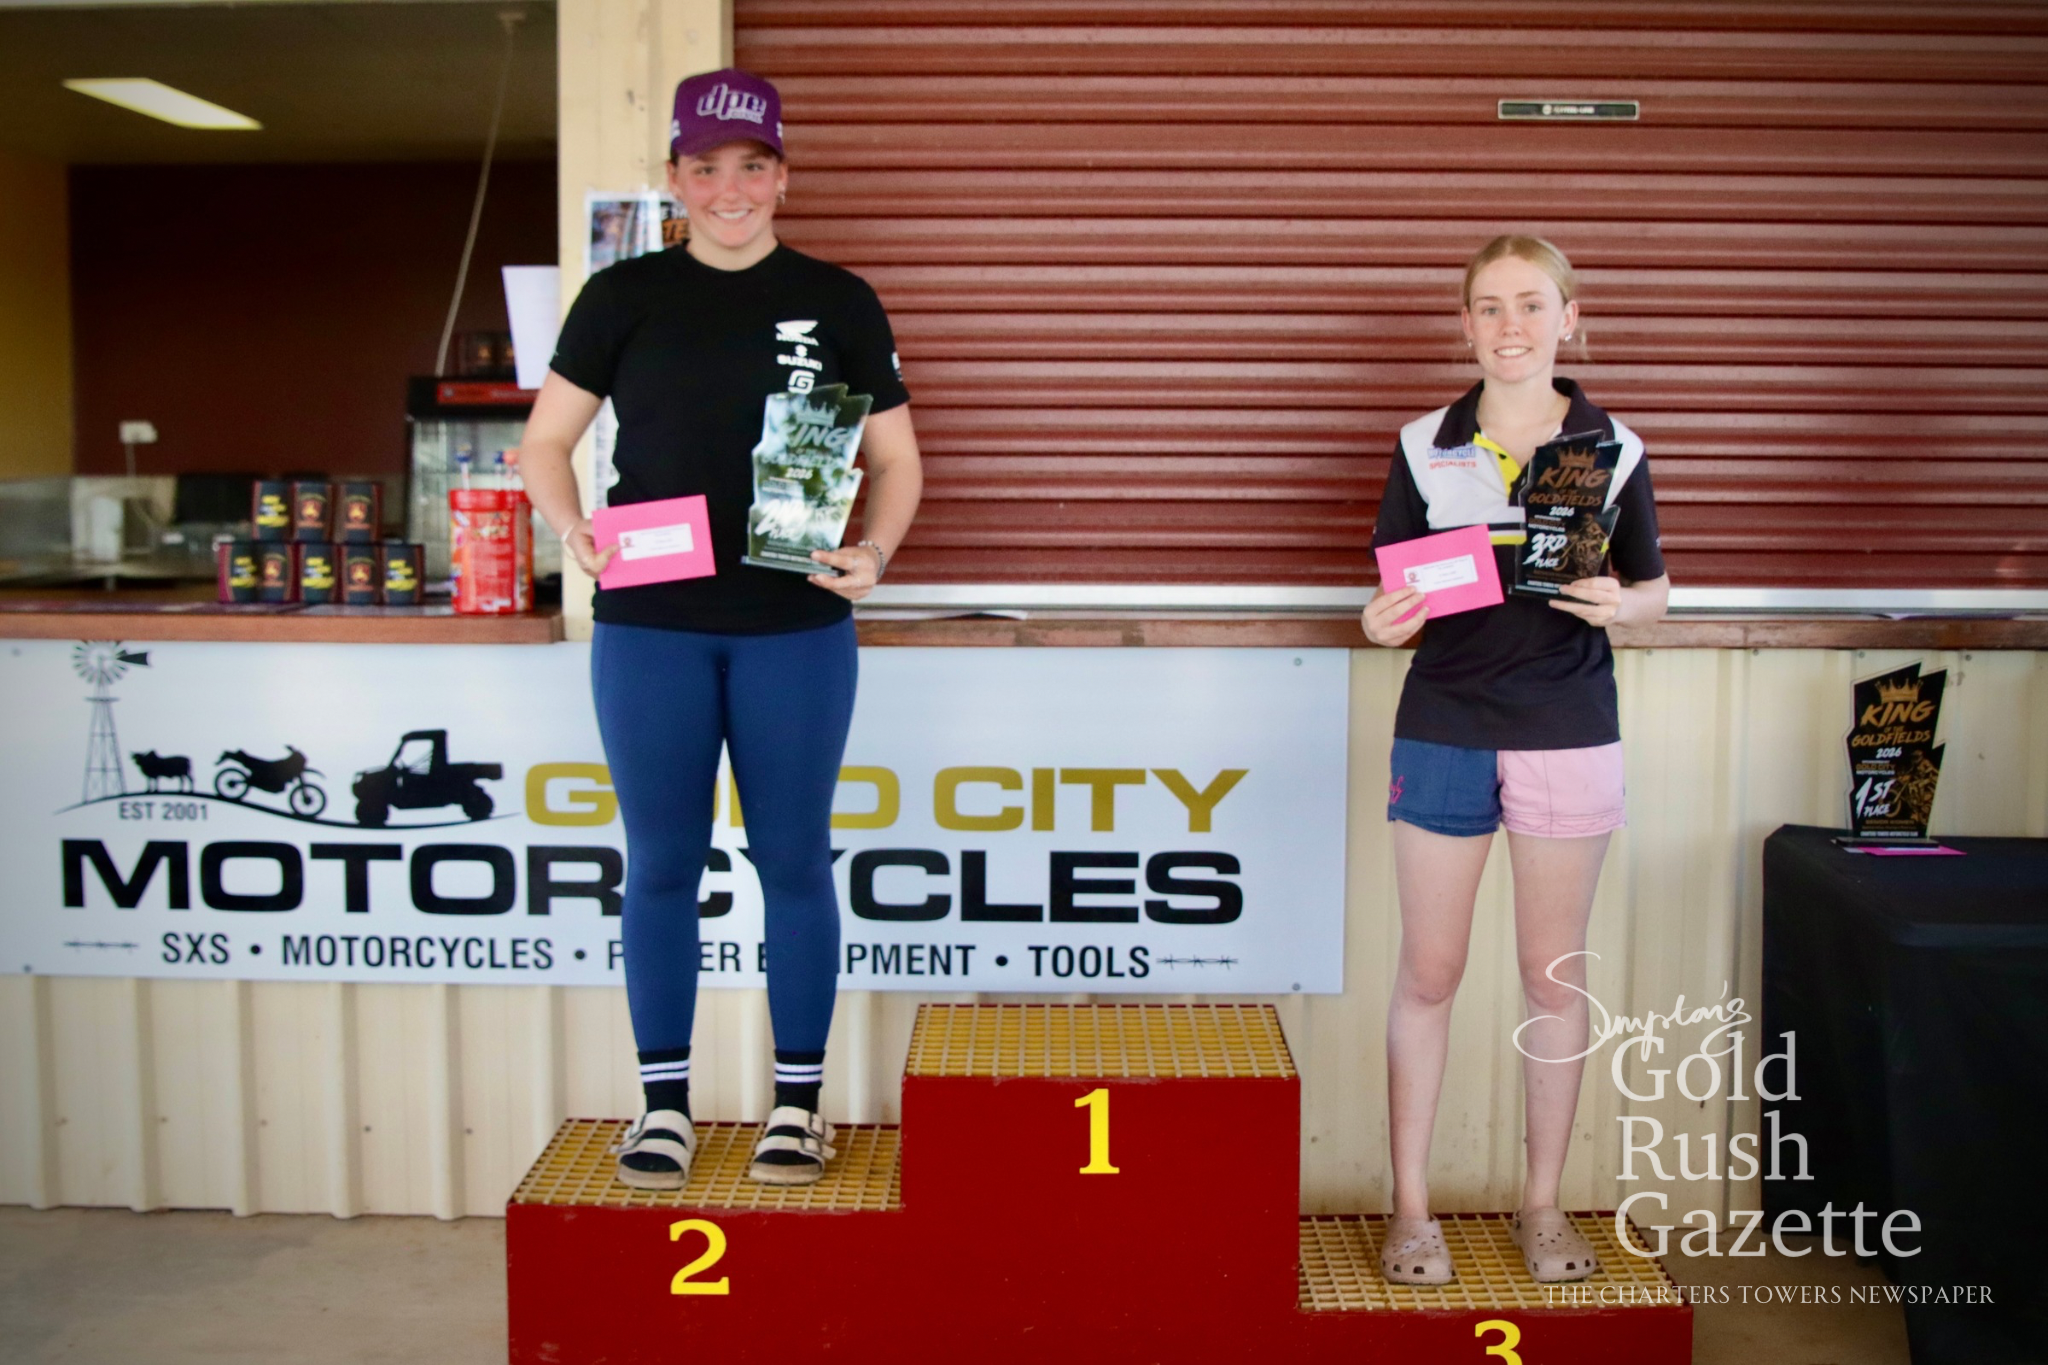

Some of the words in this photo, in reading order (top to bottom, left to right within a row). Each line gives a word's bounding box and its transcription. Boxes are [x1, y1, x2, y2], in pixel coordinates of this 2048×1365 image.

[777, 354, 823, 372] SUZUKI
[1429, 461, 1476, 470] SPECIALISTS
[1538, 466, 1609, 489] KING
[1527, 492, 1602, 507] GOLDFIELDS
[1549, 506, 1575, 517] 2026
[1522, 532, 1568, 565] 3RD
[1860, 700, 1936, 728] KING
[1851, 730, 1931, 747] GOLDFIELDS
[1875, 747, 1903, 759] 2026
[933, 766, 1249, 833] CITY
[1855, 777, 1896, 819] 1ST
[119, 802, 154, 820] EST
[163, 802, 208, 820] 2001
[1864, 804, 1890, 817] PLACE
[162, 933, 230, 964] SXS
[282, 935, 553, 970] MOTORCYCLES
[607, 941, 741, 973] PER
[1027, 945, 1150, 978] TOOLS
[1074, 1088, 1120, 1174] 1
[669, 1218, 730, 1295] 2
[1475, 1319, 1523, 1365] 3
